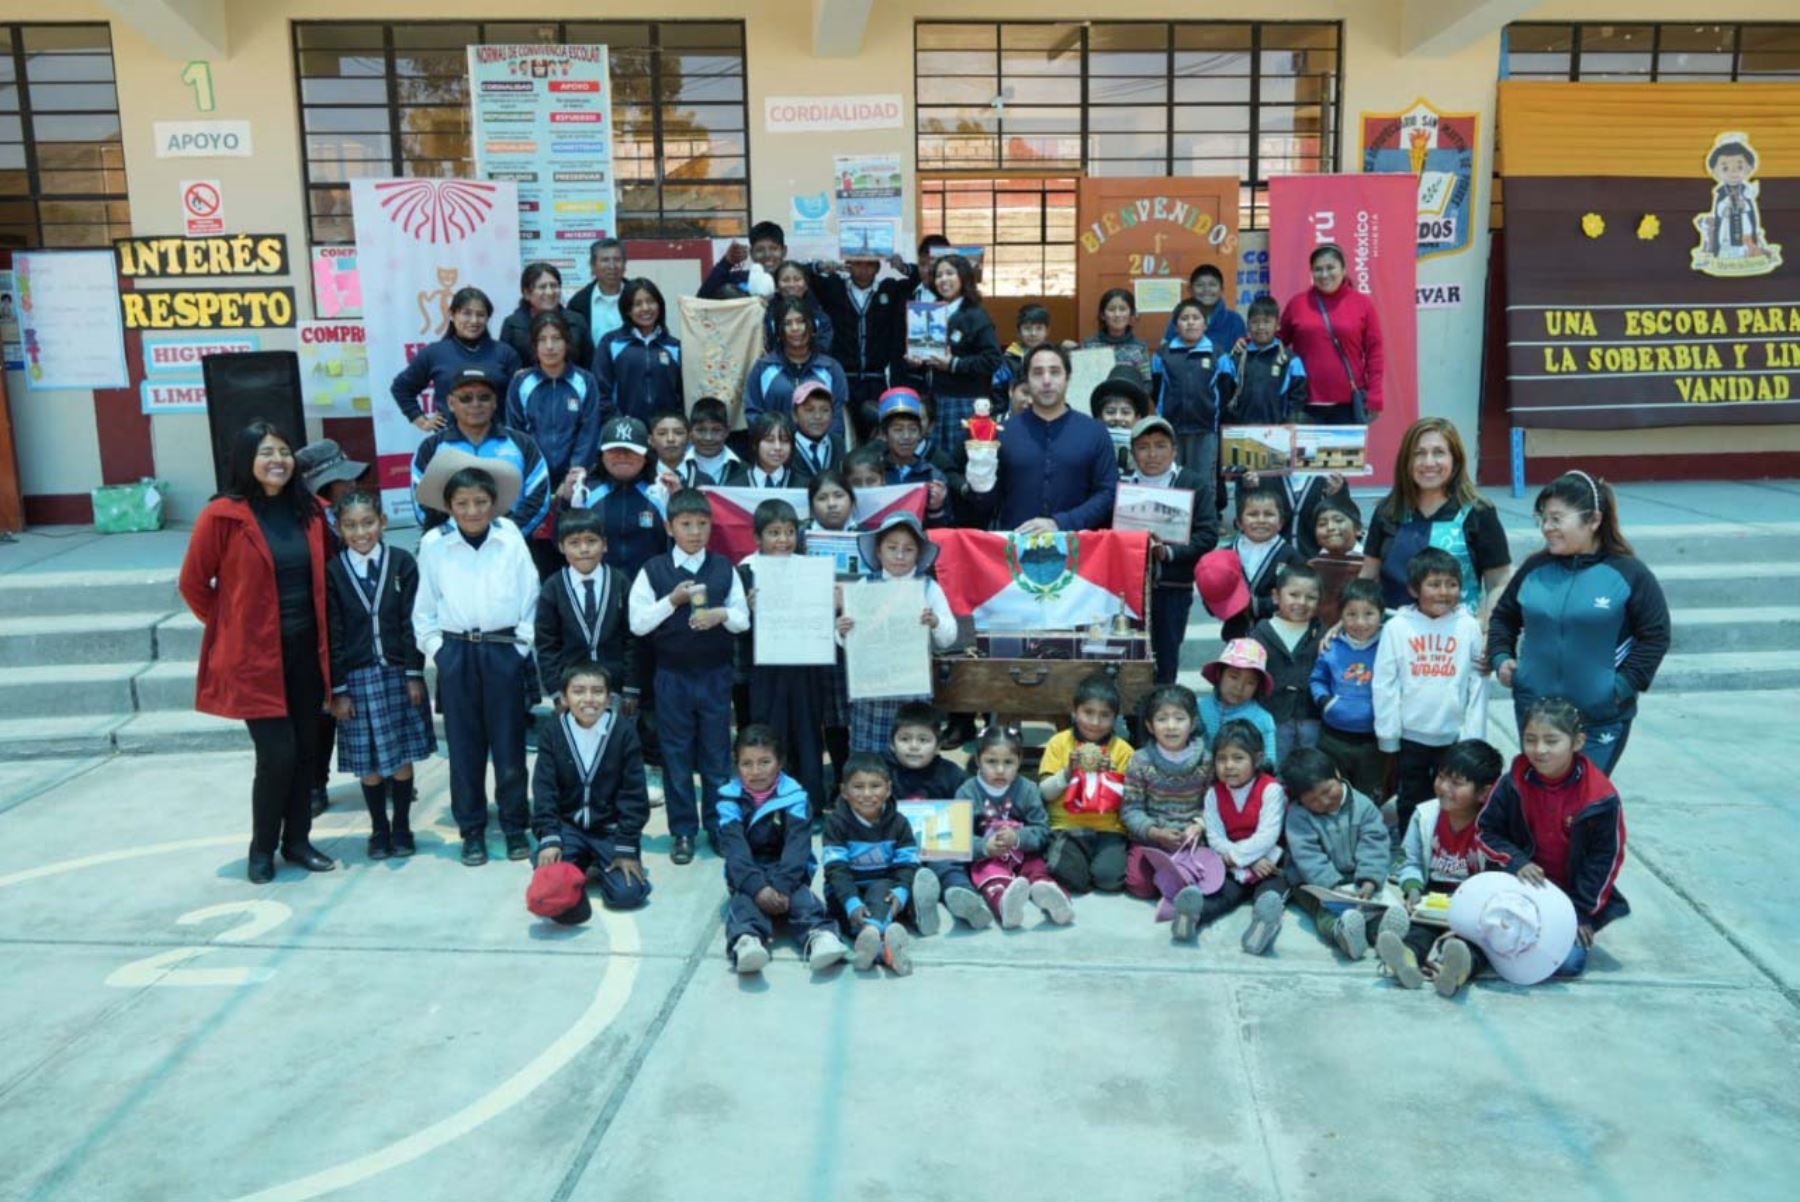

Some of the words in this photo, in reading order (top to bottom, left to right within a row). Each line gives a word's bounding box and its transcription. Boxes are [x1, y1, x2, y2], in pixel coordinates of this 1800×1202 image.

[181, 61, 215, 112] 1
[769, 103, 899, 123] CORDIALIDAD
[168, 133, 240, 151] APOYO
[1081, 196, 1239, 254] BIENVENIDOS
[1416, 220, 1453, 239] DOS
[117, 233, 283, 276] INTERÉS
[1354, 210, 1371, 294] poMéxico
[122, 291, 291, 328] RESPETO
[1545, 311, 1598, 336] UNA
[1625, 309, 1728, 335] ESCOBA
[1737, 307, 1800, 333] PARA
[1544, 347, 1578, 372] LA
[1588, 344, 1723, 371] SOBERBIA
[1733, 344, 1748, 369] Y
[1675, 375, 1790, 402] VANIDAD
[615, 423, 633, 441] NY
[1408, 633, 1456, 653] WILD
